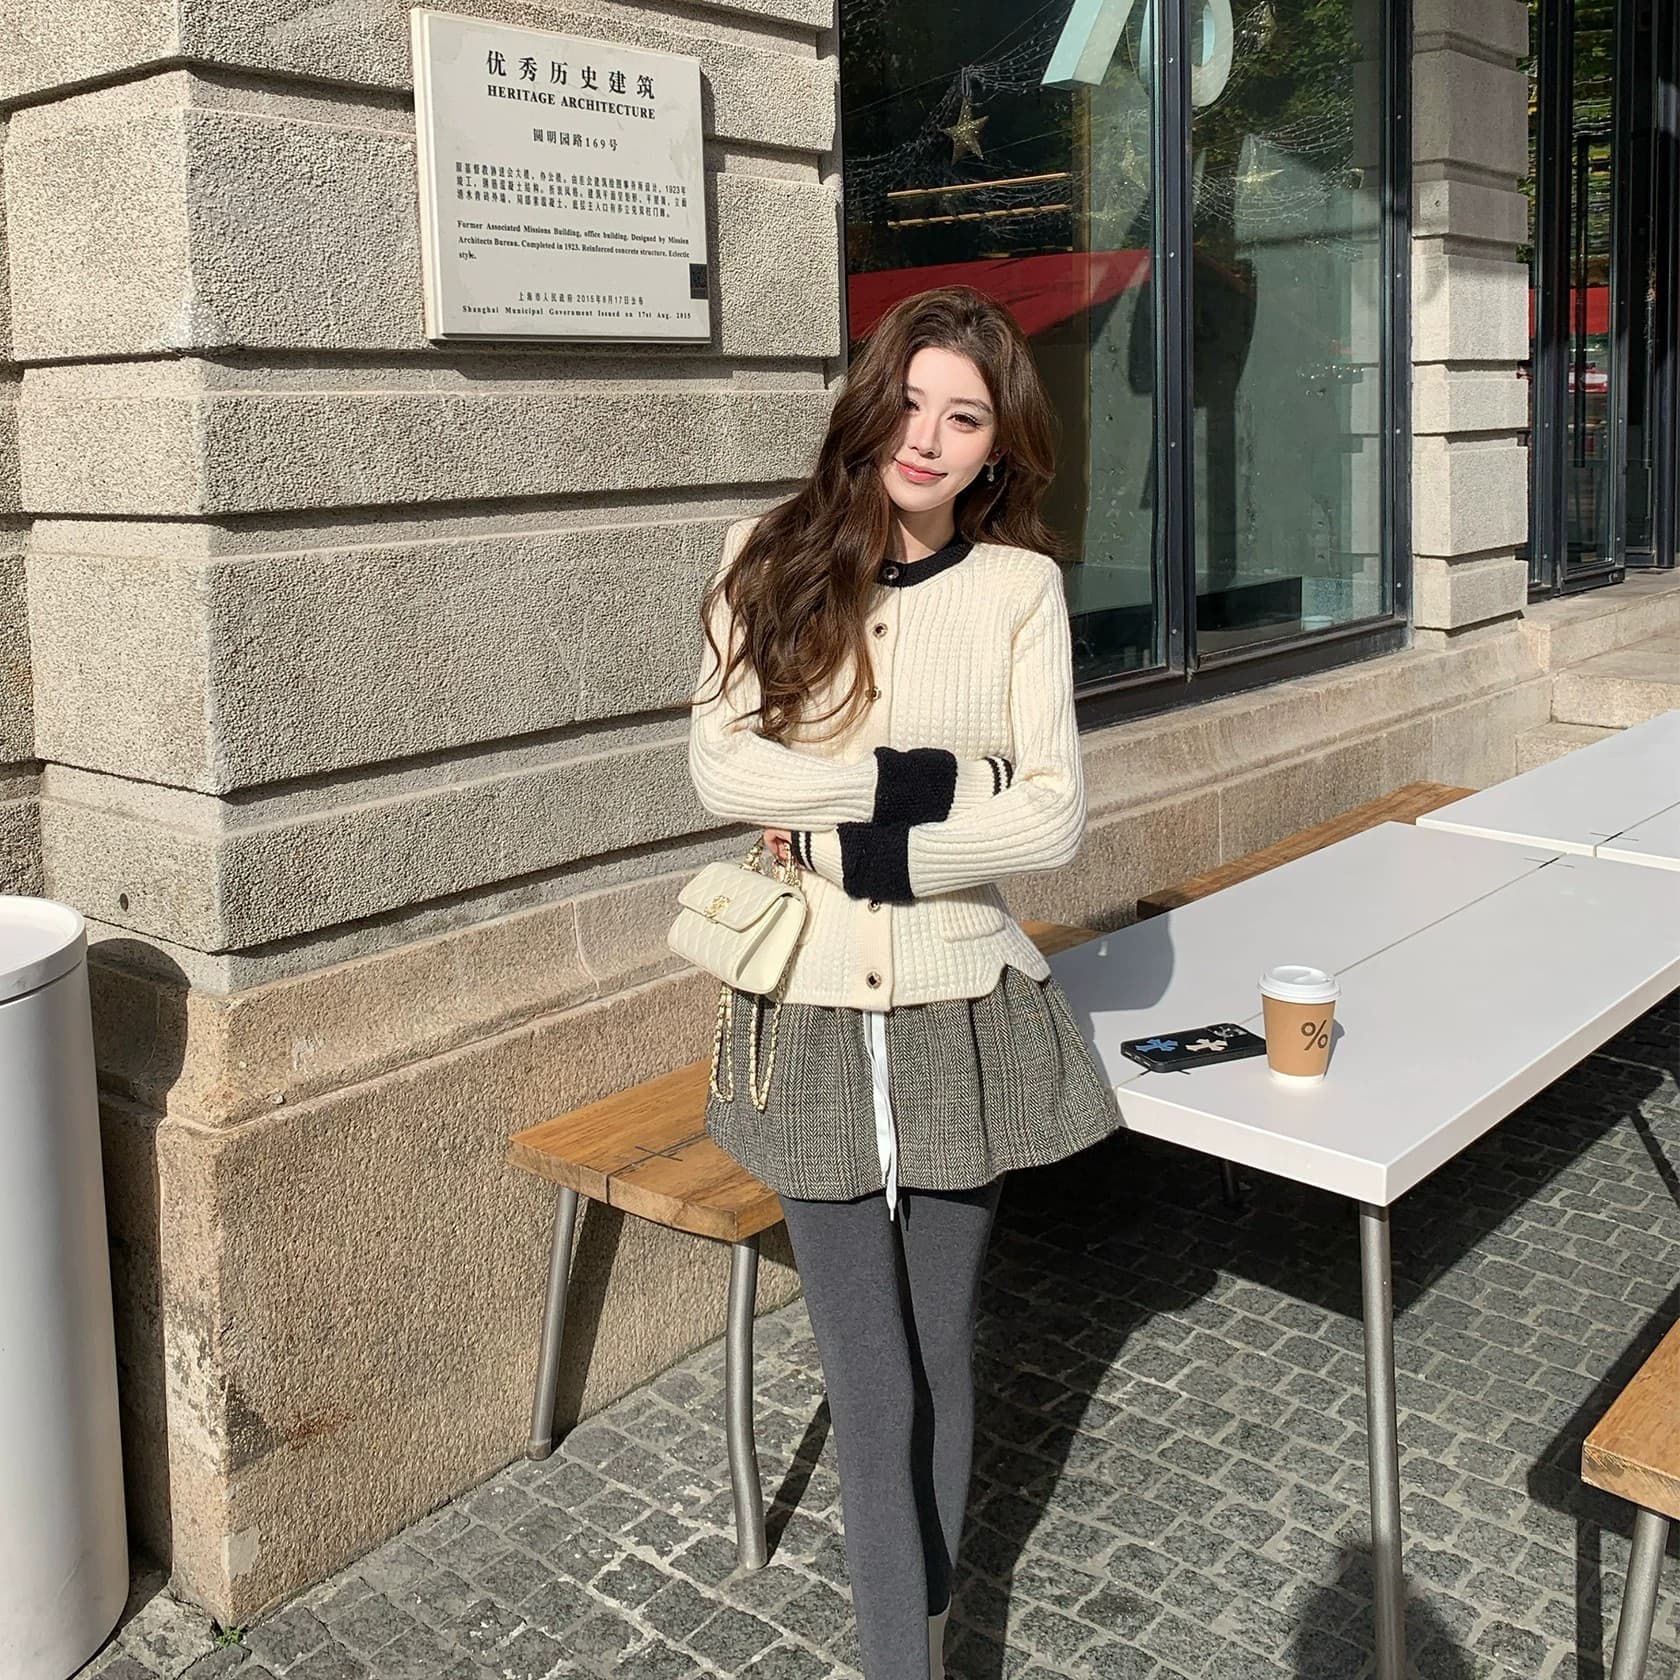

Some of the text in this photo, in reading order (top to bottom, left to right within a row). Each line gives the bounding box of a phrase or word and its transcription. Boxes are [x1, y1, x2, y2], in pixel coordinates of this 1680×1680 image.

[486, 50, 655, 99] 优秀历史建筑
[487, 84, 656, 119] HERITAGE ARCHITECTURE
[457, 220, 482, 229] Former
[487, 222, 520, 232] Associated
[524, 225, 551, 234] Missions
[584, 230, 600, 238] office
[631, 233, 656, 243] Designed
[659, 236, 665, 244] by
[459, 236, 492, 245] Architects
[521, 240, 555, 250] Completed
[557, 241, 563, 250] in
[582, 244, 613, 253] Reinforced
[615, 246, 638, 255] concrete
[669, 250, 690, 258] Eclectic
[462, 305, 499, 314] Shanghai
[505, 307, 543, 316] Municipal
[549, 308, 592, 316] Government
[676, 312, 691, 320] 2015
